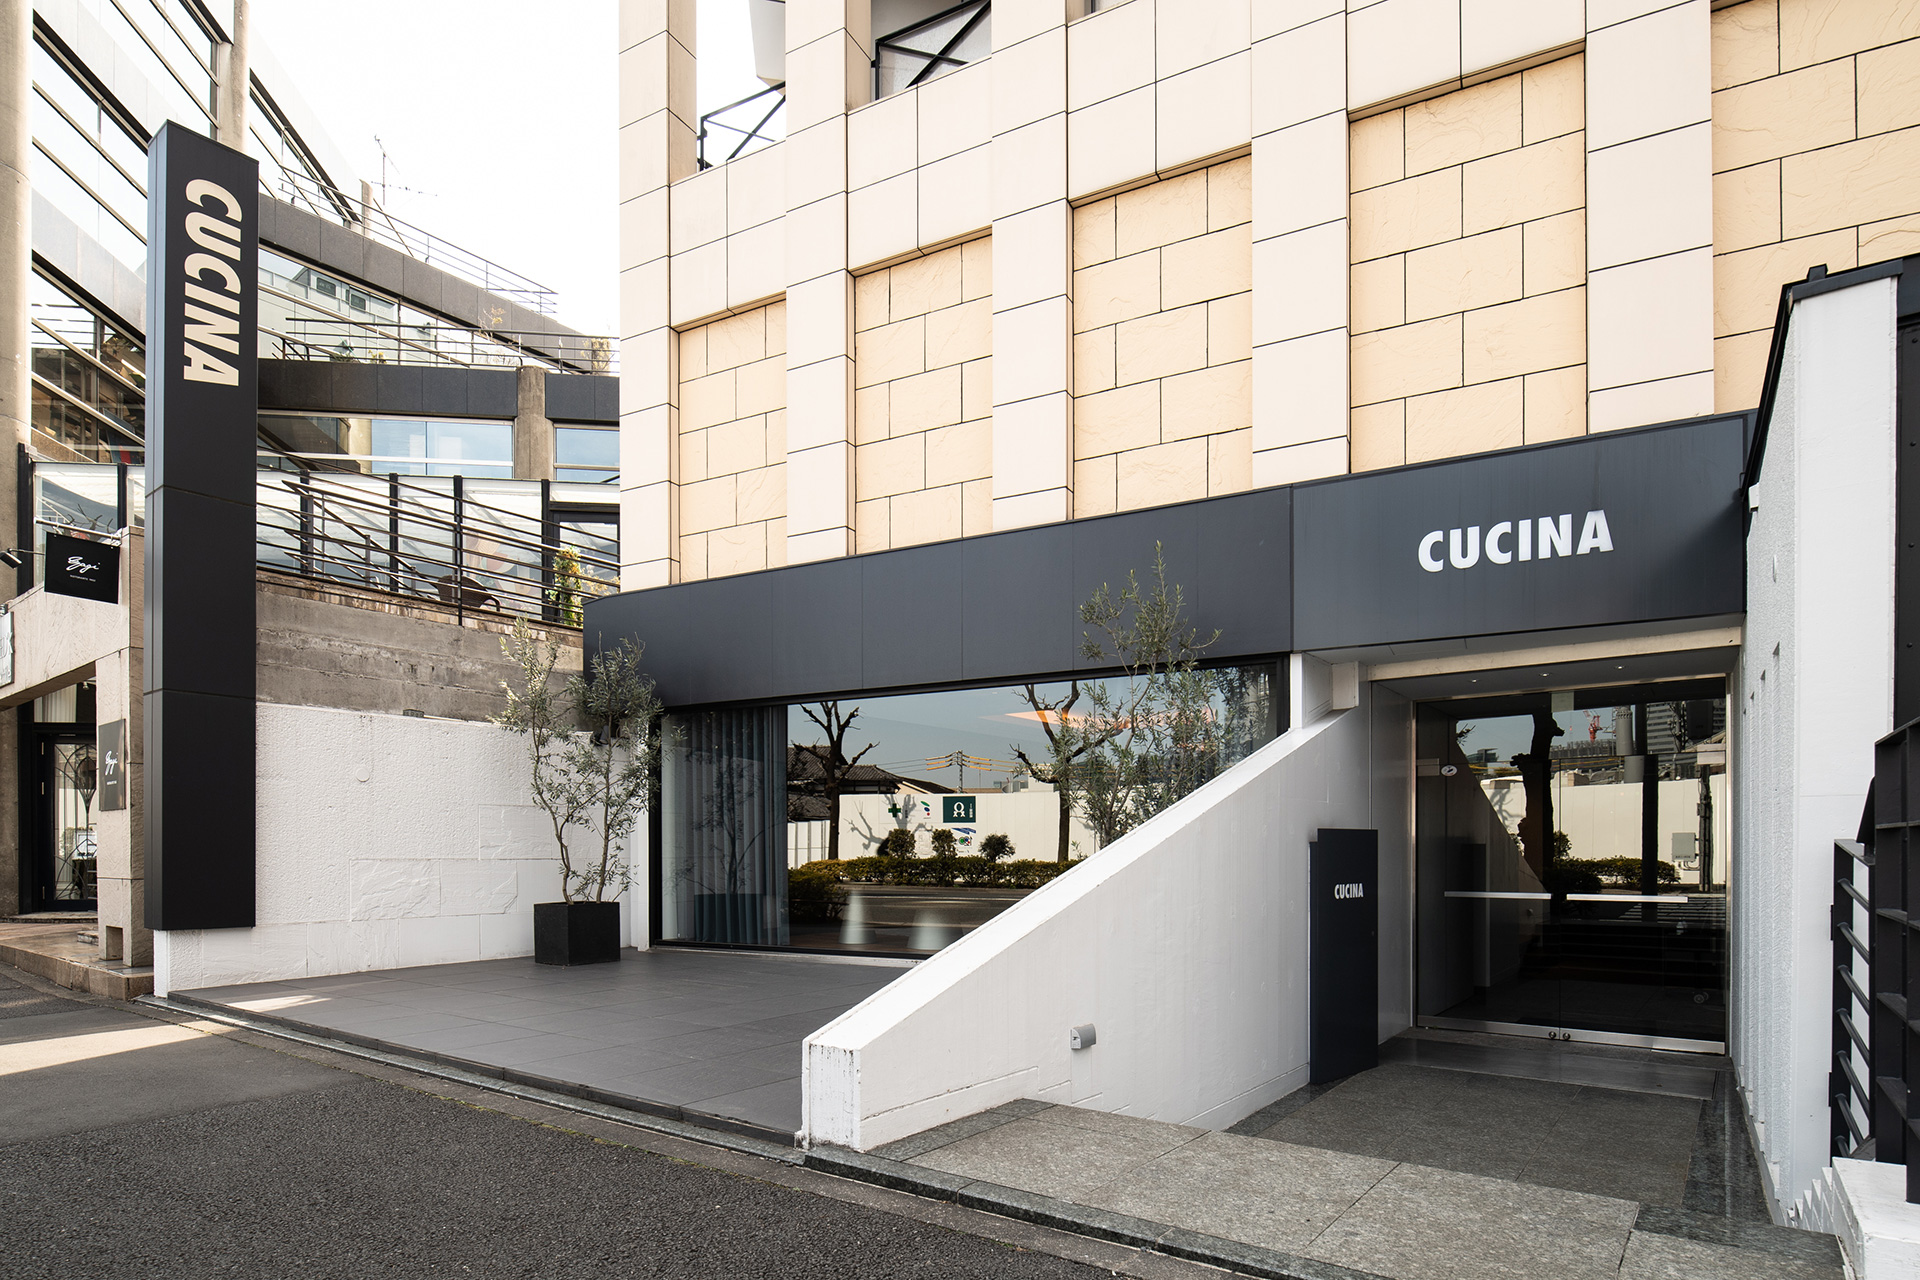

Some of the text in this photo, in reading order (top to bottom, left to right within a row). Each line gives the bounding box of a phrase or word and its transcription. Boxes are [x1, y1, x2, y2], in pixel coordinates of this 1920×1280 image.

[183, 178, 243, 387] CUCINA
[1417, 509, 1614, 573] CUCINA
[1334, 883, 1364, 900] CUCINA
